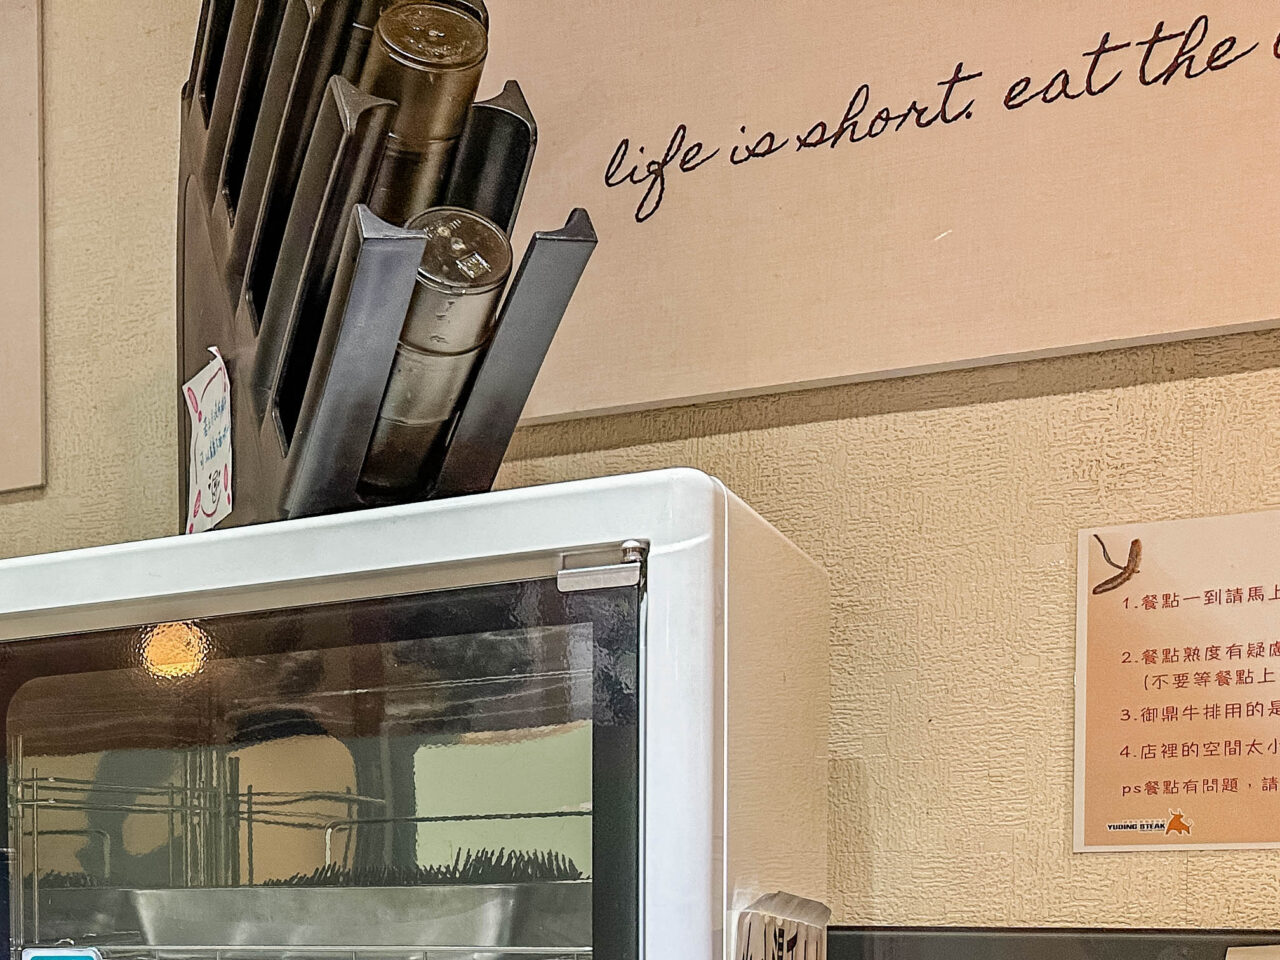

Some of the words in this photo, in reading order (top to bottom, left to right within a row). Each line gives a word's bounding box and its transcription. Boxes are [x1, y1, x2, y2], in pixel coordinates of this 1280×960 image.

[604, 124, 719, 222] life
[730, 126, 789, 164] is
[796, 62, 982, 150] short.
[1004, 32, 1131, 109] eat
[1135, 15, 1258, 85] the
